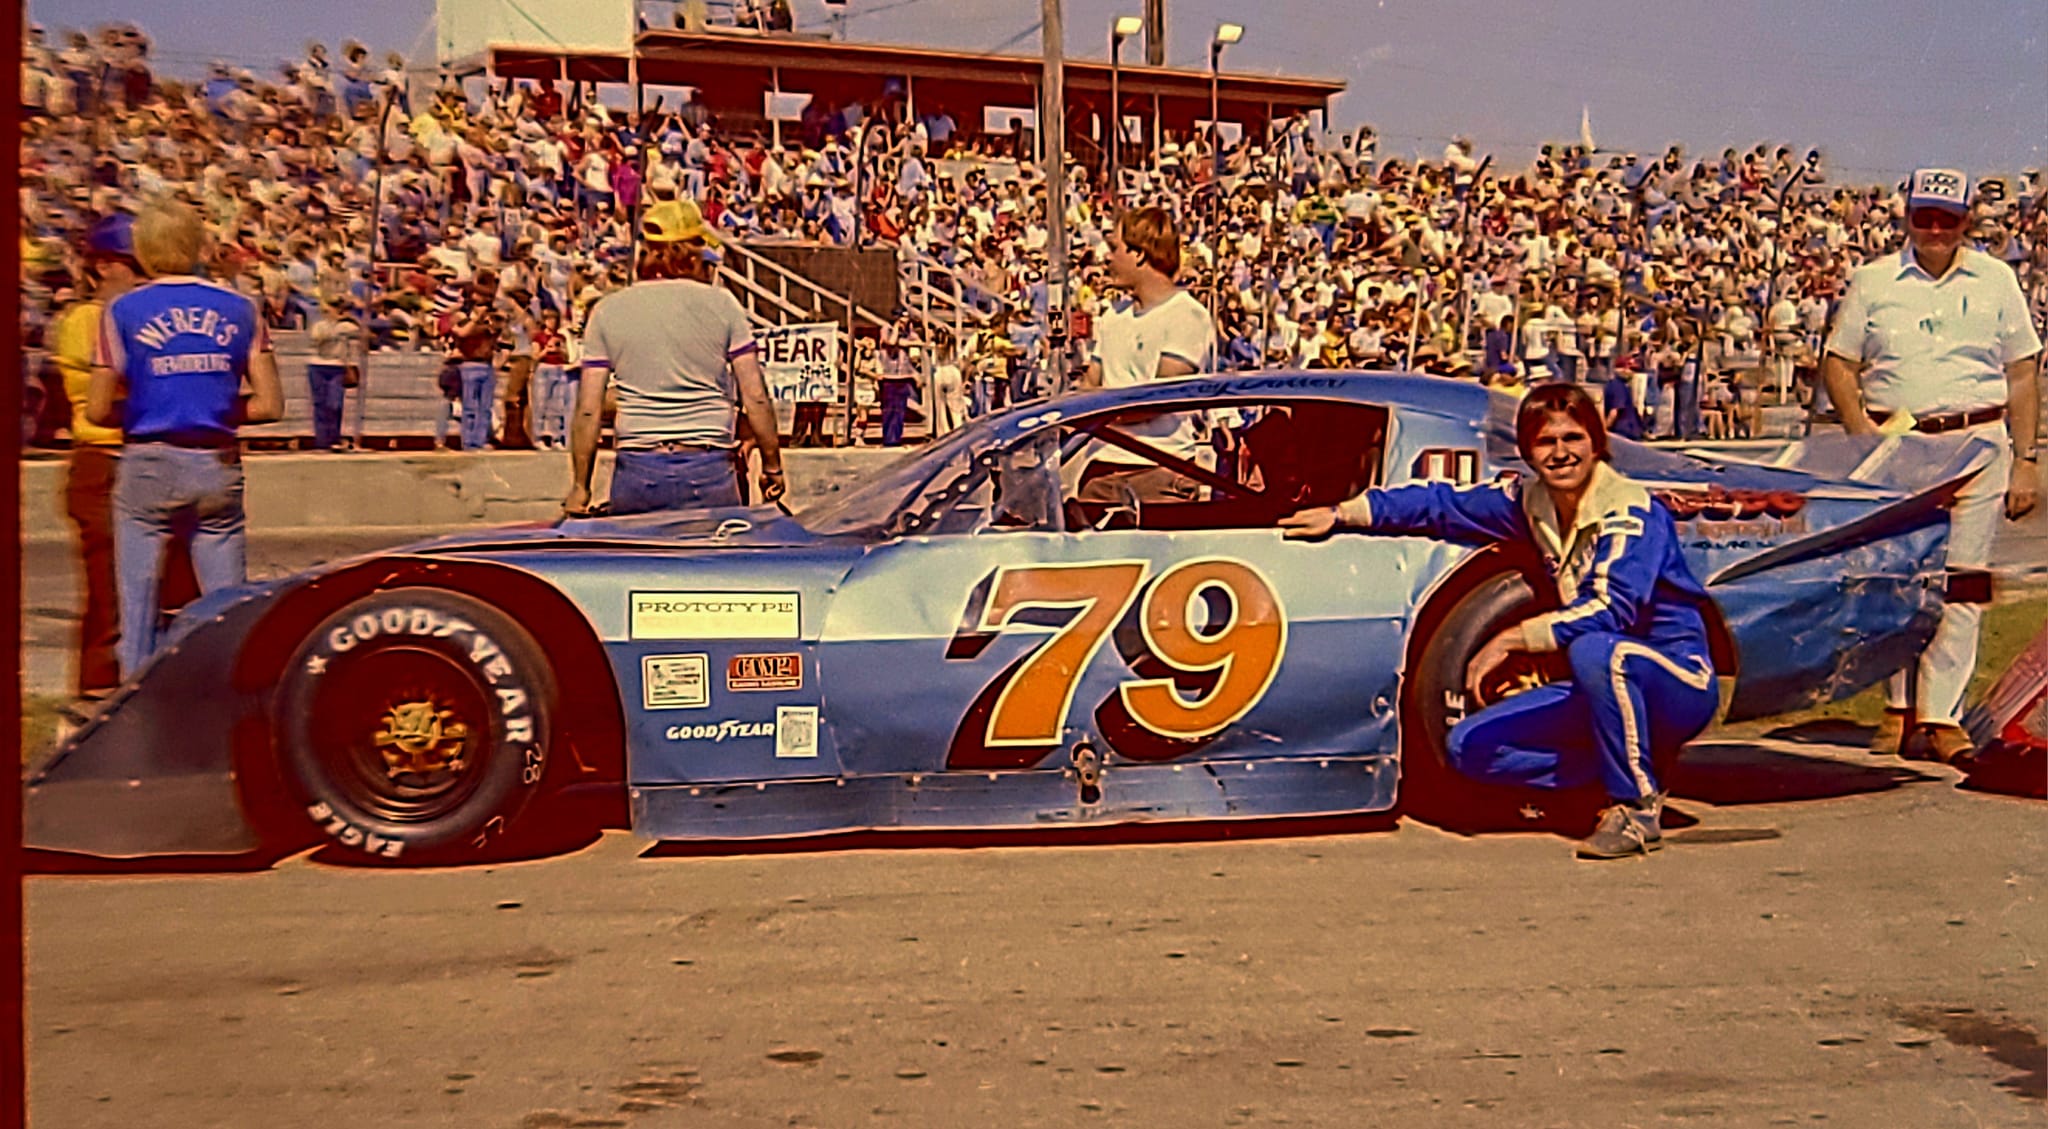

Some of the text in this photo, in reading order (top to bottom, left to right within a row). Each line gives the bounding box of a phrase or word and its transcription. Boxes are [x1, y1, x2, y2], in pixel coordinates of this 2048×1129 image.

[134, 306, 239, 350] WEBER'S
[756, 337, 827, 363] HEAR
[637, 602, 794, 613] PROTOTYPE
[329, 607, 534, 743] GOODYEAR
[948, 556, 1289, 764] 79
[666, 719, 776, 743] GOODYEAR
[306, 801, 405, 858] EAGLE
